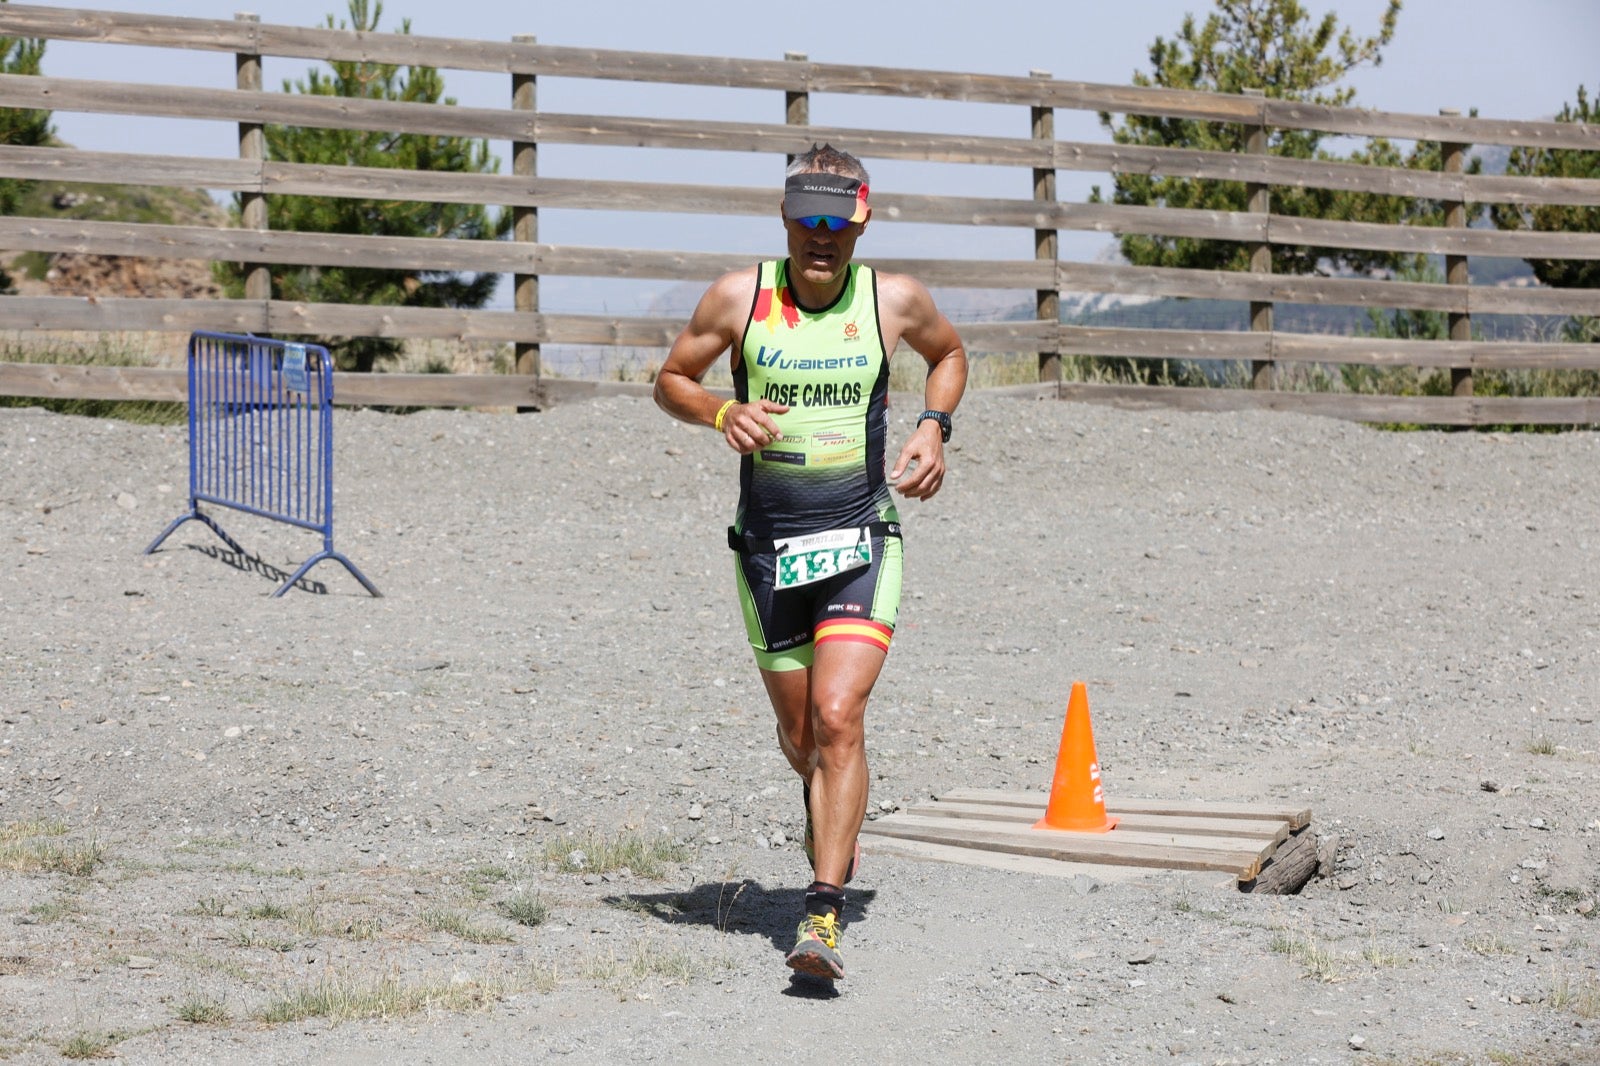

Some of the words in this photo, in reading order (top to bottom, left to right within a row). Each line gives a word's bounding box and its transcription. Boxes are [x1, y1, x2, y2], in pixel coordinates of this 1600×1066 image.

[802, 185, 846, 194] SALOMON
[760, 382, 799, 407] JOSE
[802, 382, 861, 407] CARLOS
